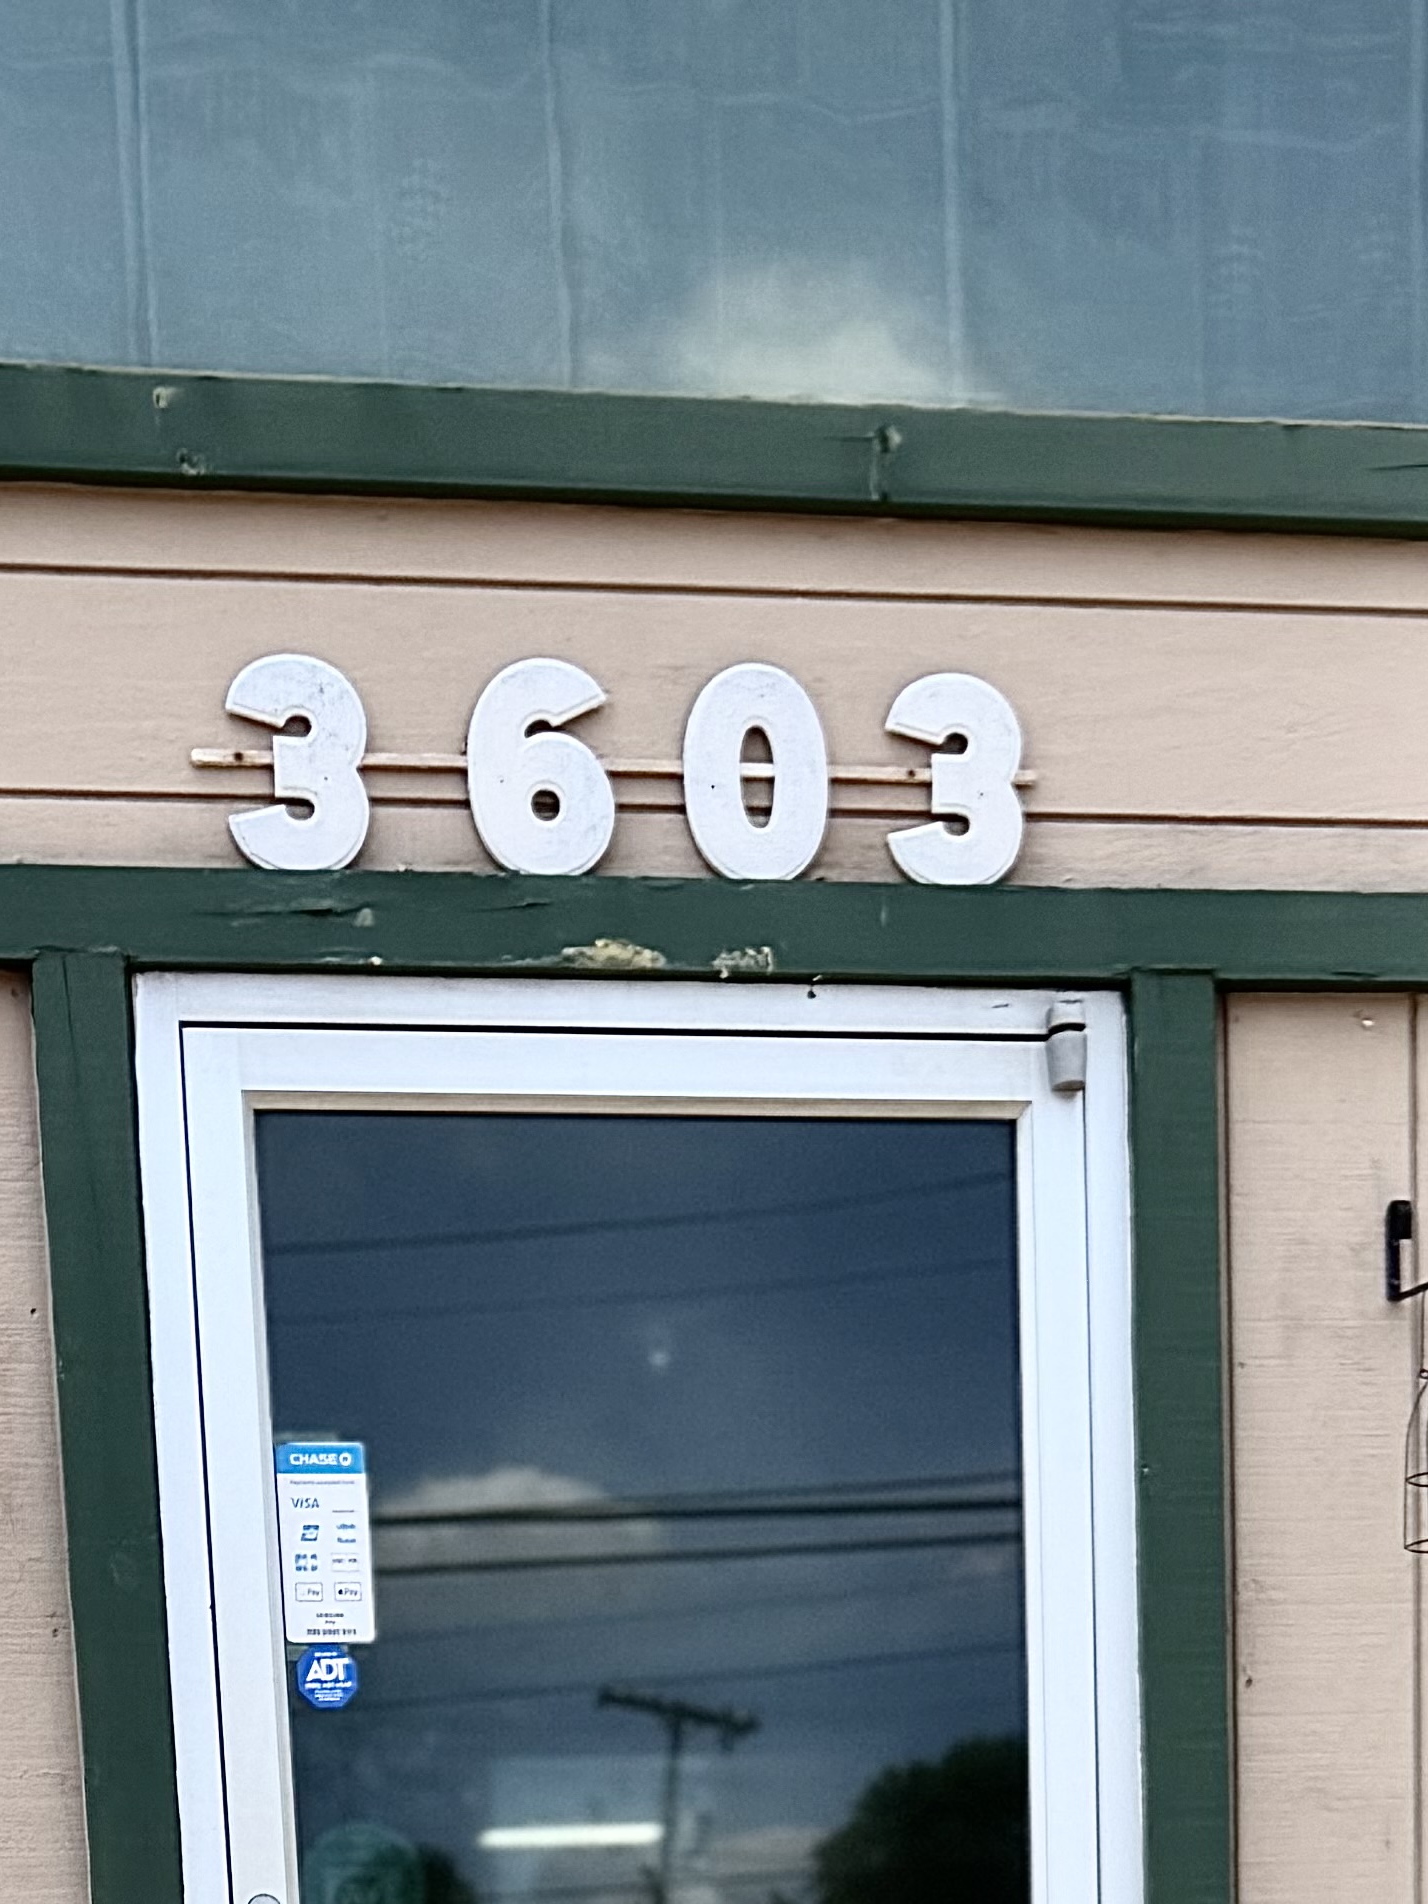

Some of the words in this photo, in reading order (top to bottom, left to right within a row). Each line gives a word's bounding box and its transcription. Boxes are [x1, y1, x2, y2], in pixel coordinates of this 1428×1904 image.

[225, 653, 1024, 886] 3603
[290, 1453, 338, 1466] CHASE
[290, 1497, 320, 1509] VISA
[306, 1658, 349, 1681] ADT
